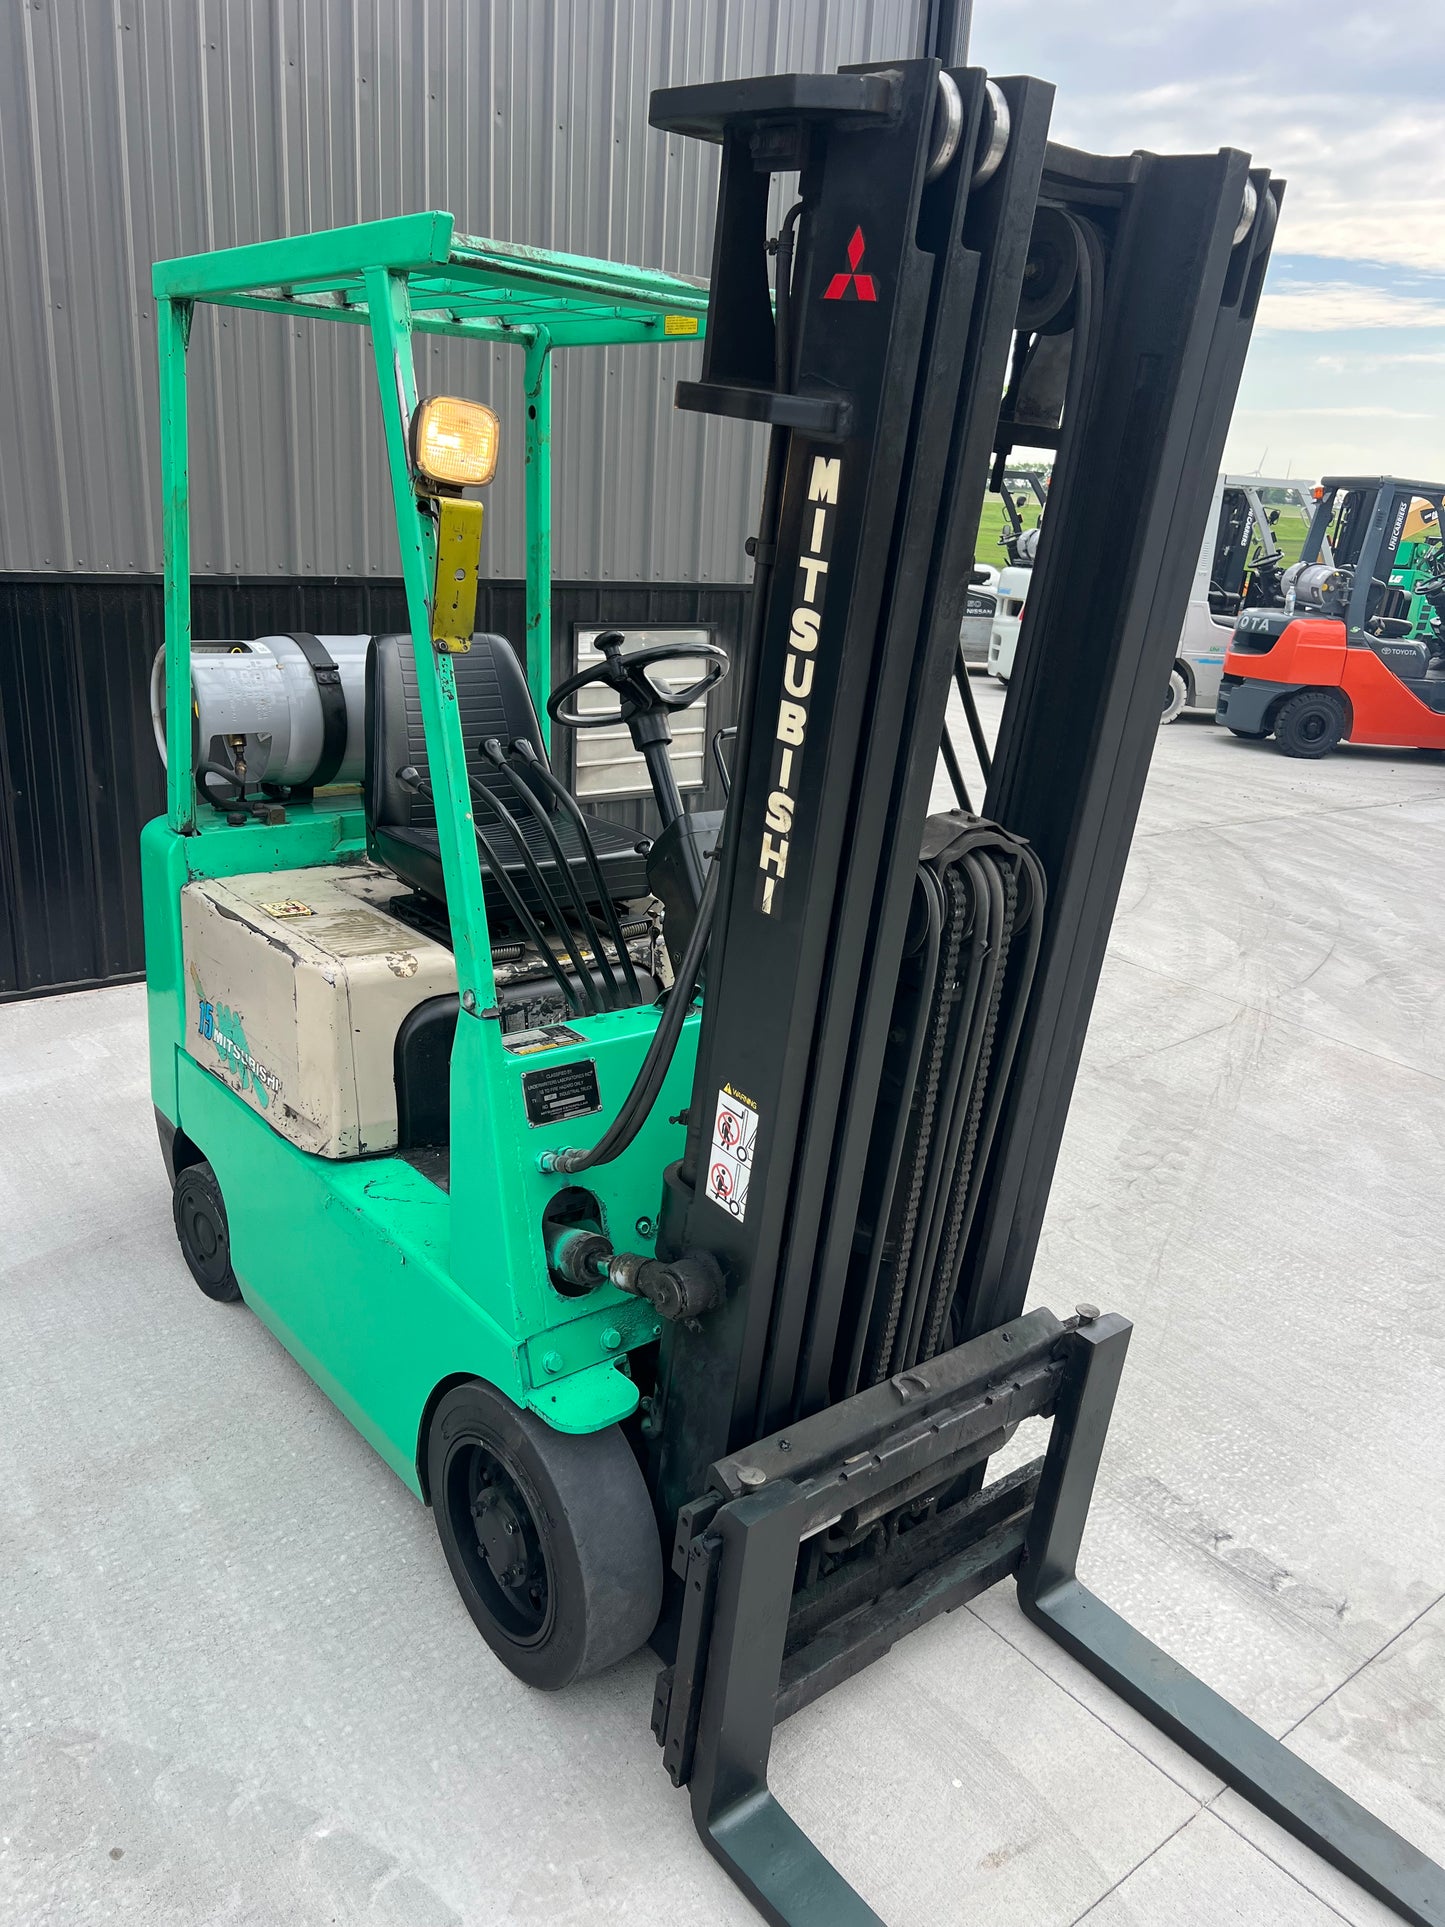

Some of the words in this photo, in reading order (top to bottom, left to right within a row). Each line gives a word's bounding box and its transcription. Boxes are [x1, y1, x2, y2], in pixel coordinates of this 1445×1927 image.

[1388, 501, 1407, 551] UNICARRIERS
[1240, 615, 1269, 630] OTA
[1391, 648, 1417, 656] TOYOTA
[759, 456, 841, 915] MITSUBISHI
[199, 1000, 214, 1040] 15
[213, 1028, 280, 1091] MITSUBISHI
[732, 1087, 757, 1110] WARNING
